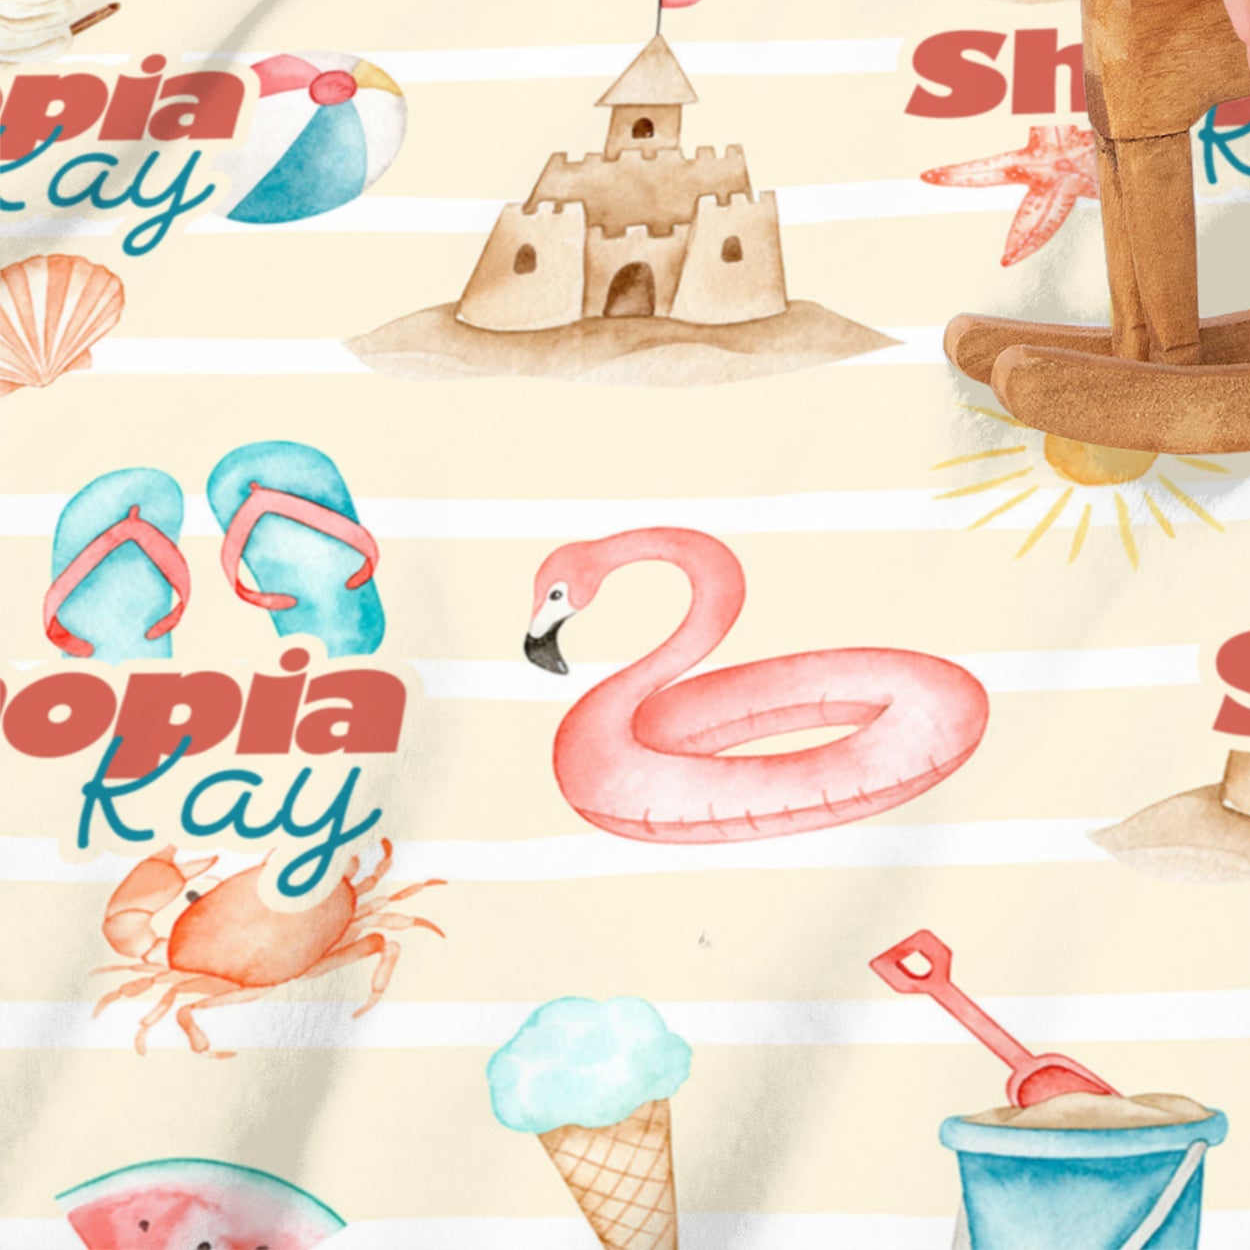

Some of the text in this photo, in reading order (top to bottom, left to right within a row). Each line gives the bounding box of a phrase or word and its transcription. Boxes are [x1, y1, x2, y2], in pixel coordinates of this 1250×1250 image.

[0, 53, 246, 161] pia
[0, 646, 407, 779] opia
[77, 735, 383, 898] Kay
